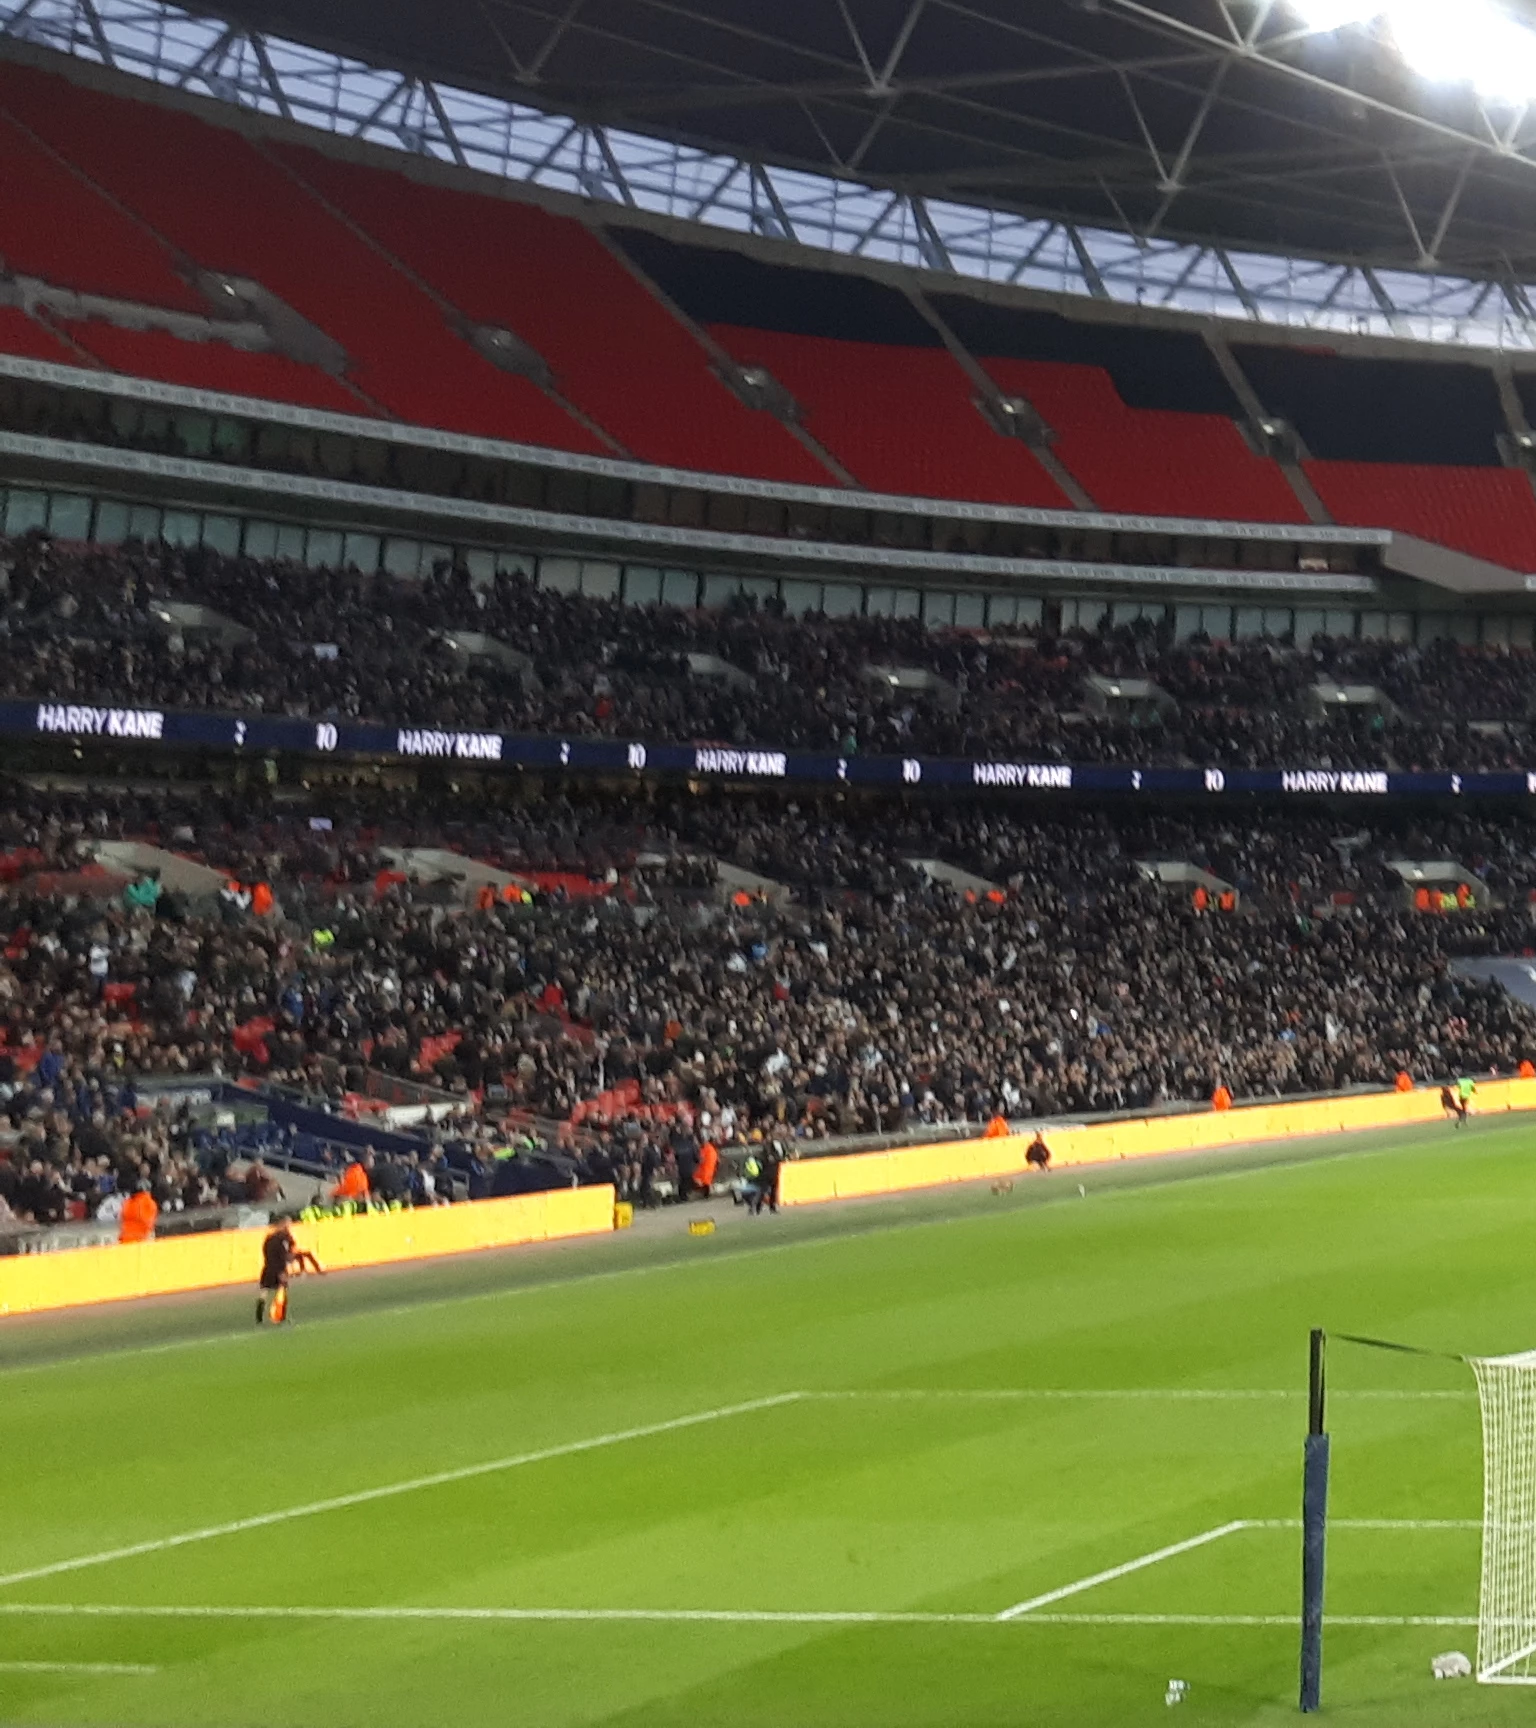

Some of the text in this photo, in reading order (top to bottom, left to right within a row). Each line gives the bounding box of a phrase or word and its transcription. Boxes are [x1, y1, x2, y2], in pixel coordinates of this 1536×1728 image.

[37, 705, 163, 738] HARRY KANE
[317, 723, 337, 750] 10
[398, 730, 502, 759] HARRY KANE
[628, 744, 646, 768] 10
[696, 750, 786, 775] HARRY KANE
[903, 759, 920, 782] 10
[974, 764, 1071, 787] HARRY KANE
[1205, 769, 1224, 791] 10
[1283, 771, 1387, 792] HARRY KANE
